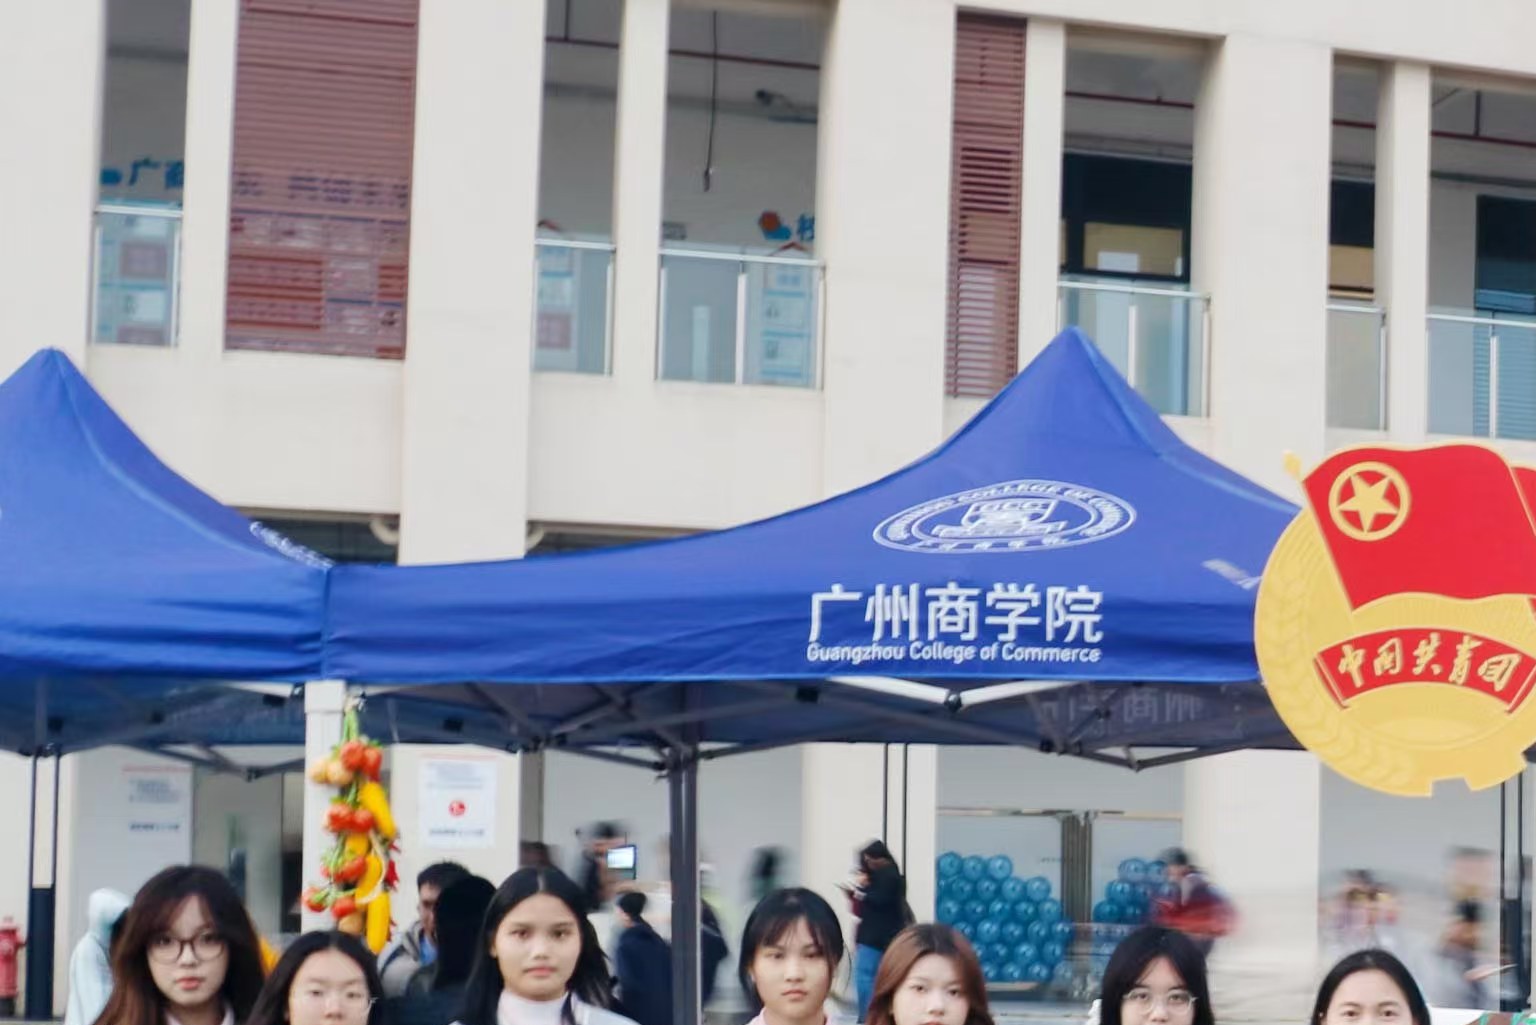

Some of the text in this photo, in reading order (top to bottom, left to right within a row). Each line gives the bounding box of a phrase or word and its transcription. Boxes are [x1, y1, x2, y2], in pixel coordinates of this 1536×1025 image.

[808, 582, 1105, 643] 广州商学院
[807, 641, 1101, 665] Guangzhou College of Commerce
[1337, 632, 1525, 692] 中国共青团
